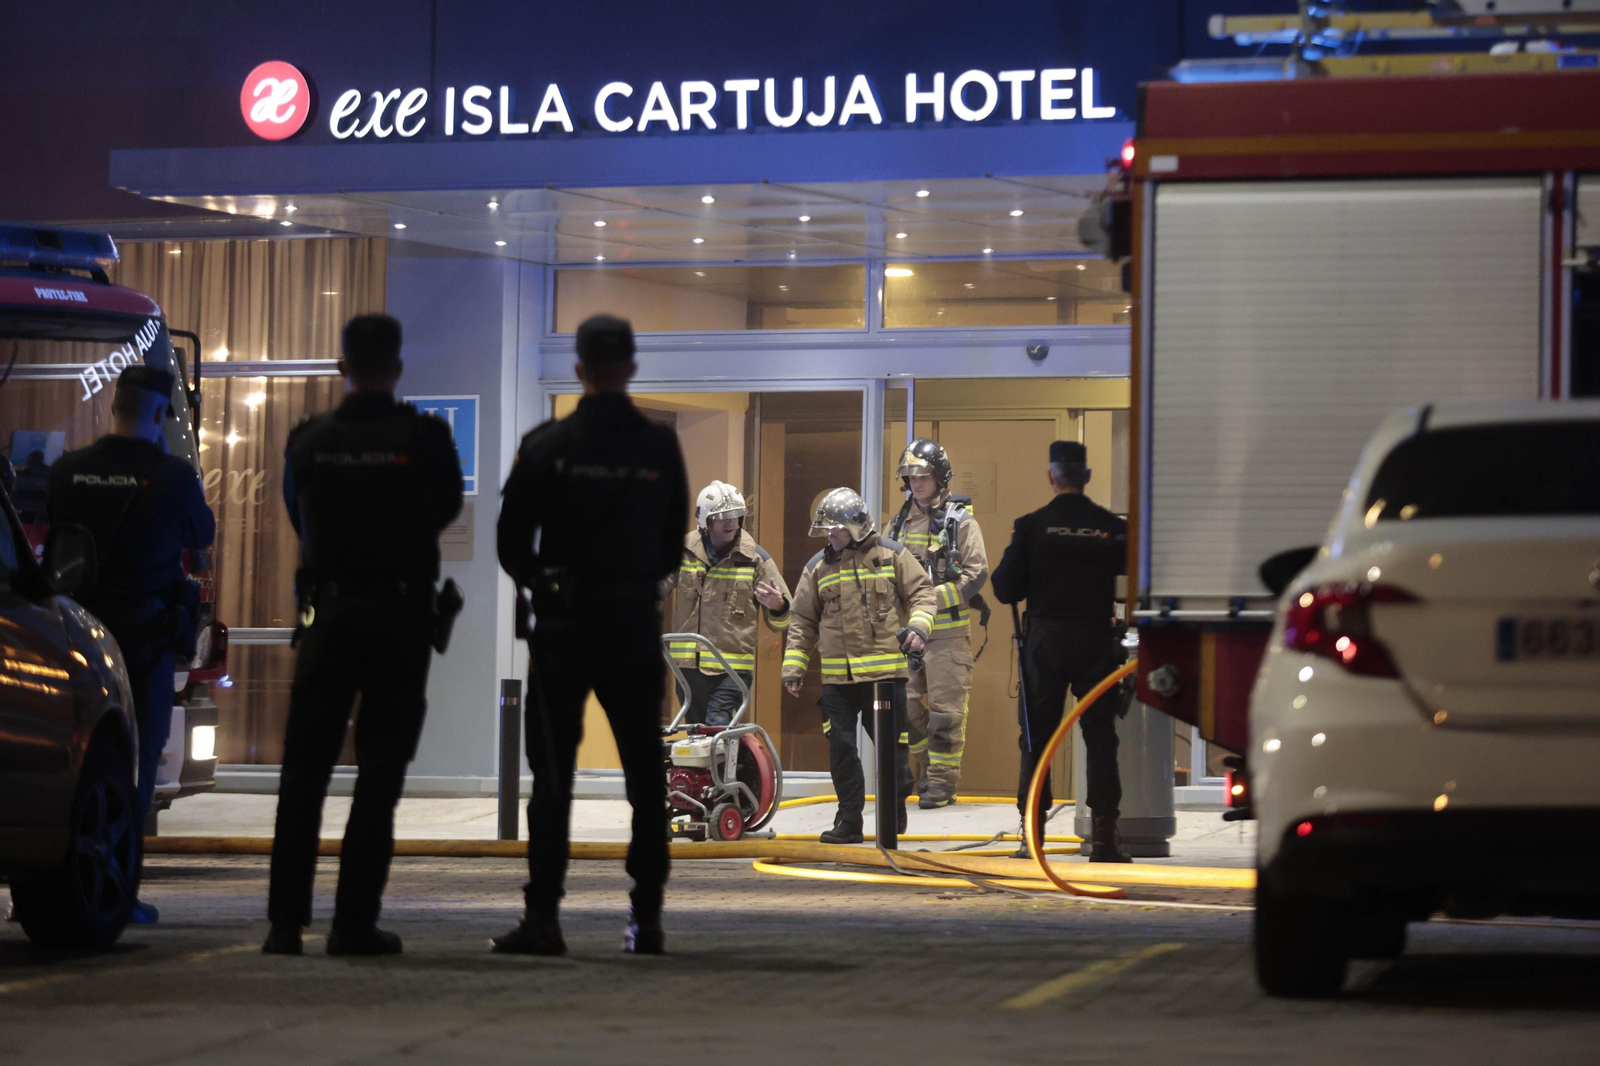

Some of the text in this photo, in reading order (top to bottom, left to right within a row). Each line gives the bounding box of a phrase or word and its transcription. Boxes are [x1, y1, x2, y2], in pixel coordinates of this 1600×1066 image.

[329, 67, 1116, 138] exe ISLA CARTUJA HOTEL
[73, 474, 138, 486] POLICIA
[1047, 526, 1102, 537] POLICIA
